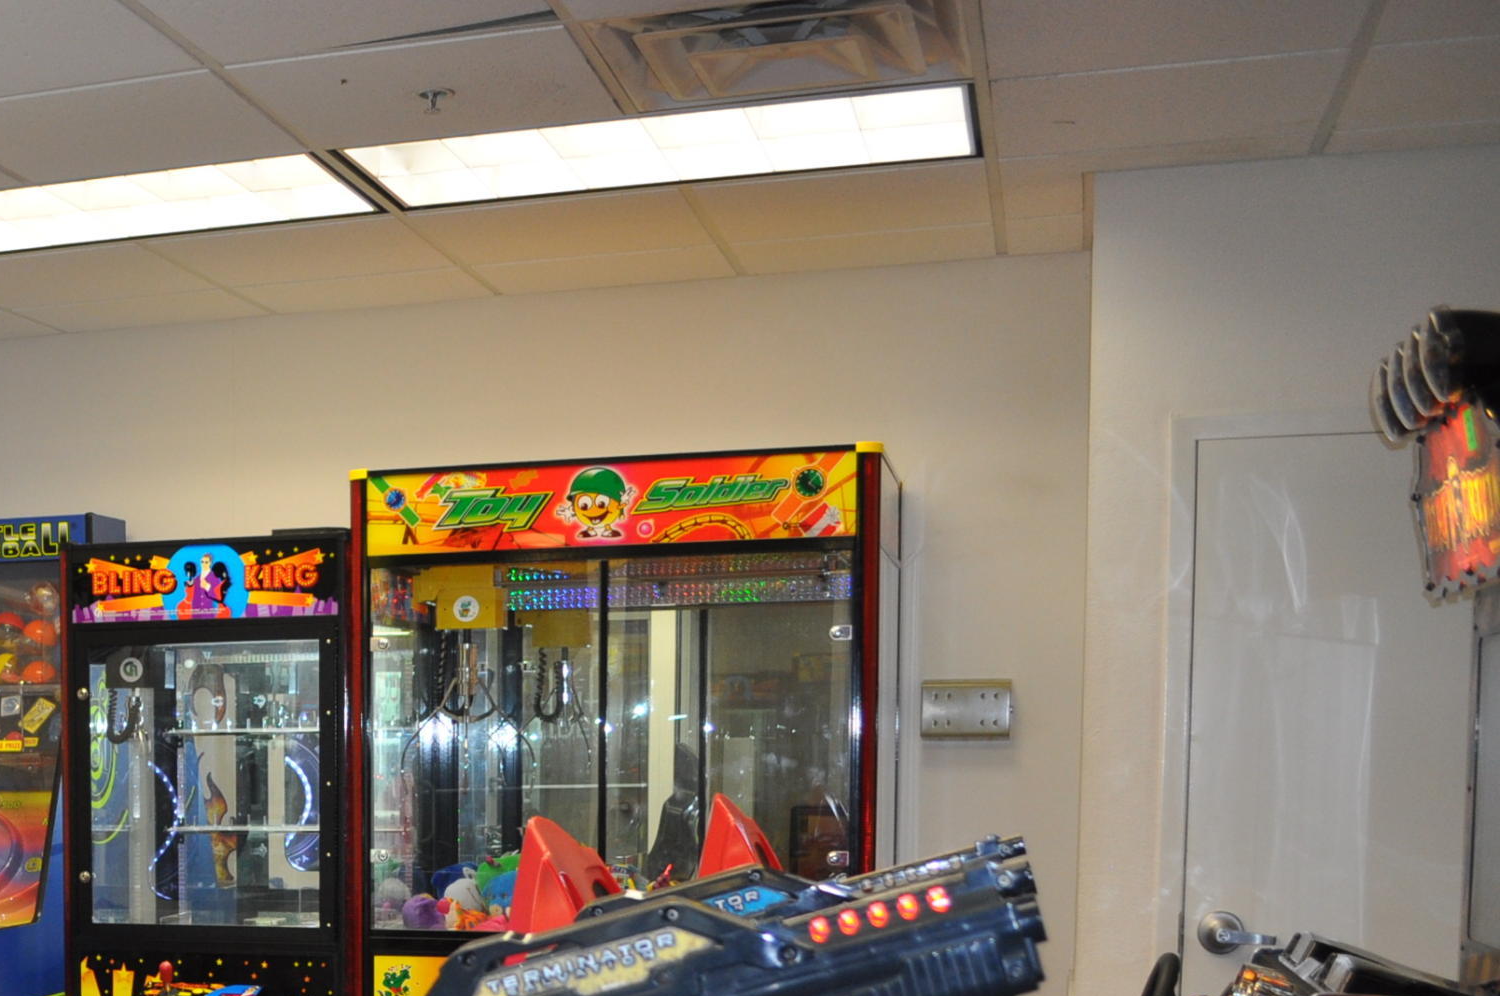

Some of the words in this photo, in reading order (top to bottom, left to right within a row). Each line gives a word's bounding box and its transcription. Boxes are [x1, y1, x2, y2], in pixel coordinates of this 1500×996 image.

[432, 486, 554, 533] Toy
[631, 475, 790, 516] Soldier
[91, 568, 178, 596] BLING
[243, 562, 320, 591] KING
[486, 932, 676, 992] TERMINATOR
